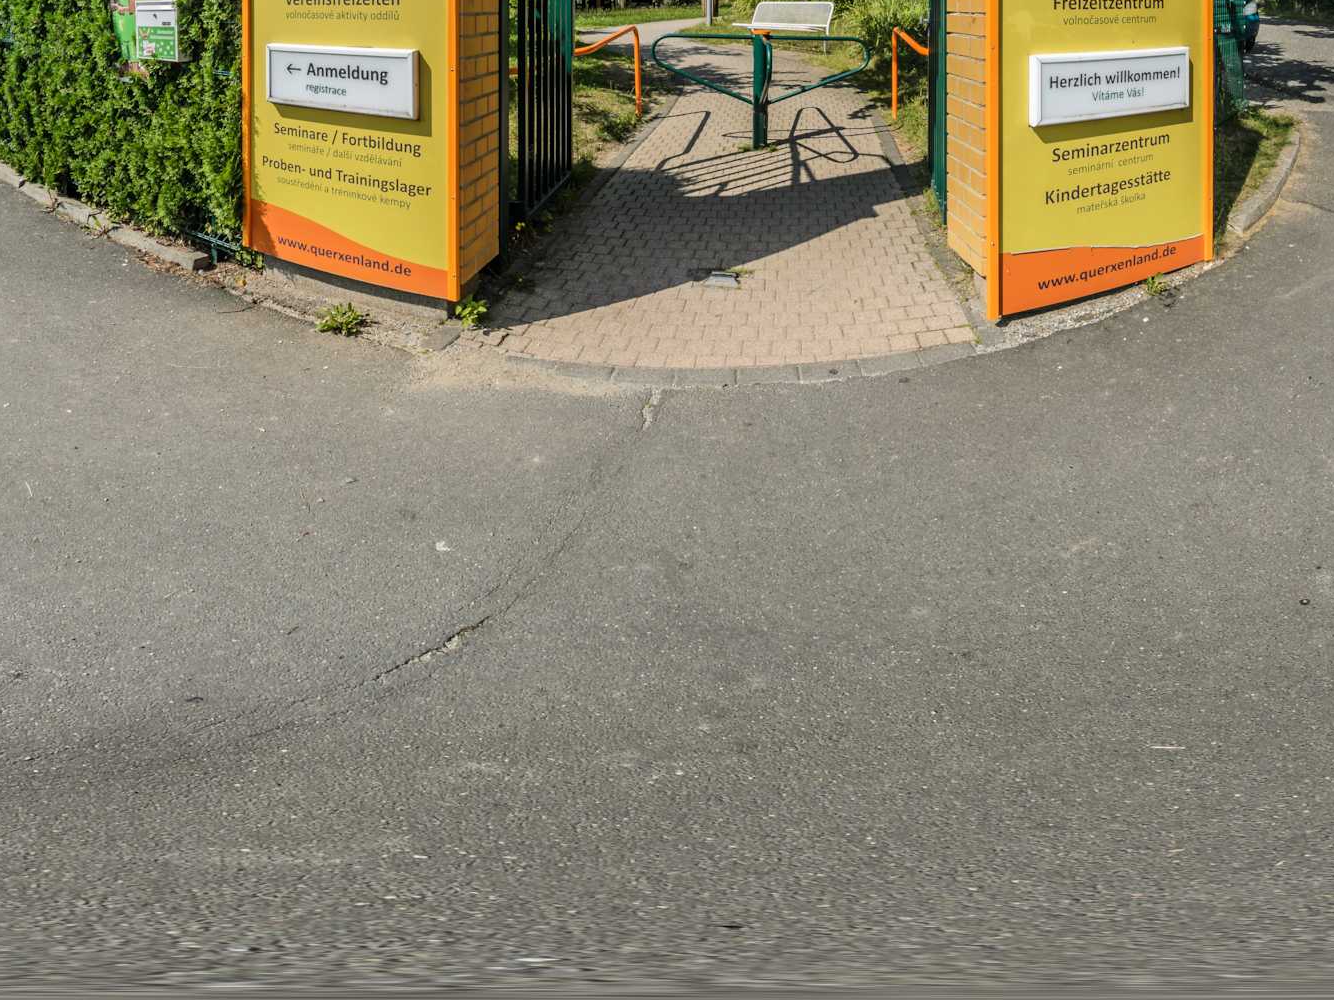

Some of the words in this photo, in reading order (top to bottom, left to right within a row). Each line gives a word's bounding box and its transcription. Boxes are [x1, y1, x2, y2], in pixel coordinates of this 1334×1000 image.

[336, 10, 368, 21] aktivity
[1121, 15, 1157, 24] centrum
[306, 62, 388, 85] Anmeldung
[1049, 70, 1101, 89] Herzlich
[1105, 66, 1181, 85] willkommen!
[306, 83, 347, 97] registrace
[1092, 89, 1124, 102] Vítáme
[1126, 87, 1145, 99] Vás!
[274, 122, 328, 142] Seminare
[332, 129, 338, 145] /
[342, 132, 422, 158] Fortbildung
[1052, 133, 1170, 162] Seminarzentrum
[1118, 153, 1154, 167] centrum
[262, 155, 306, 174] Proben-
[309, 166, 332, 179] und
[336, 169, 432, 197] Trainingslager
[1045, 170, 1171, 205] Kindertagesstätte
[380, 196, 411, 210] kempy
[277, 235, 412, 277] www.querxenland.de
[1037, 245, 1177, 291] www.querxenland.de
